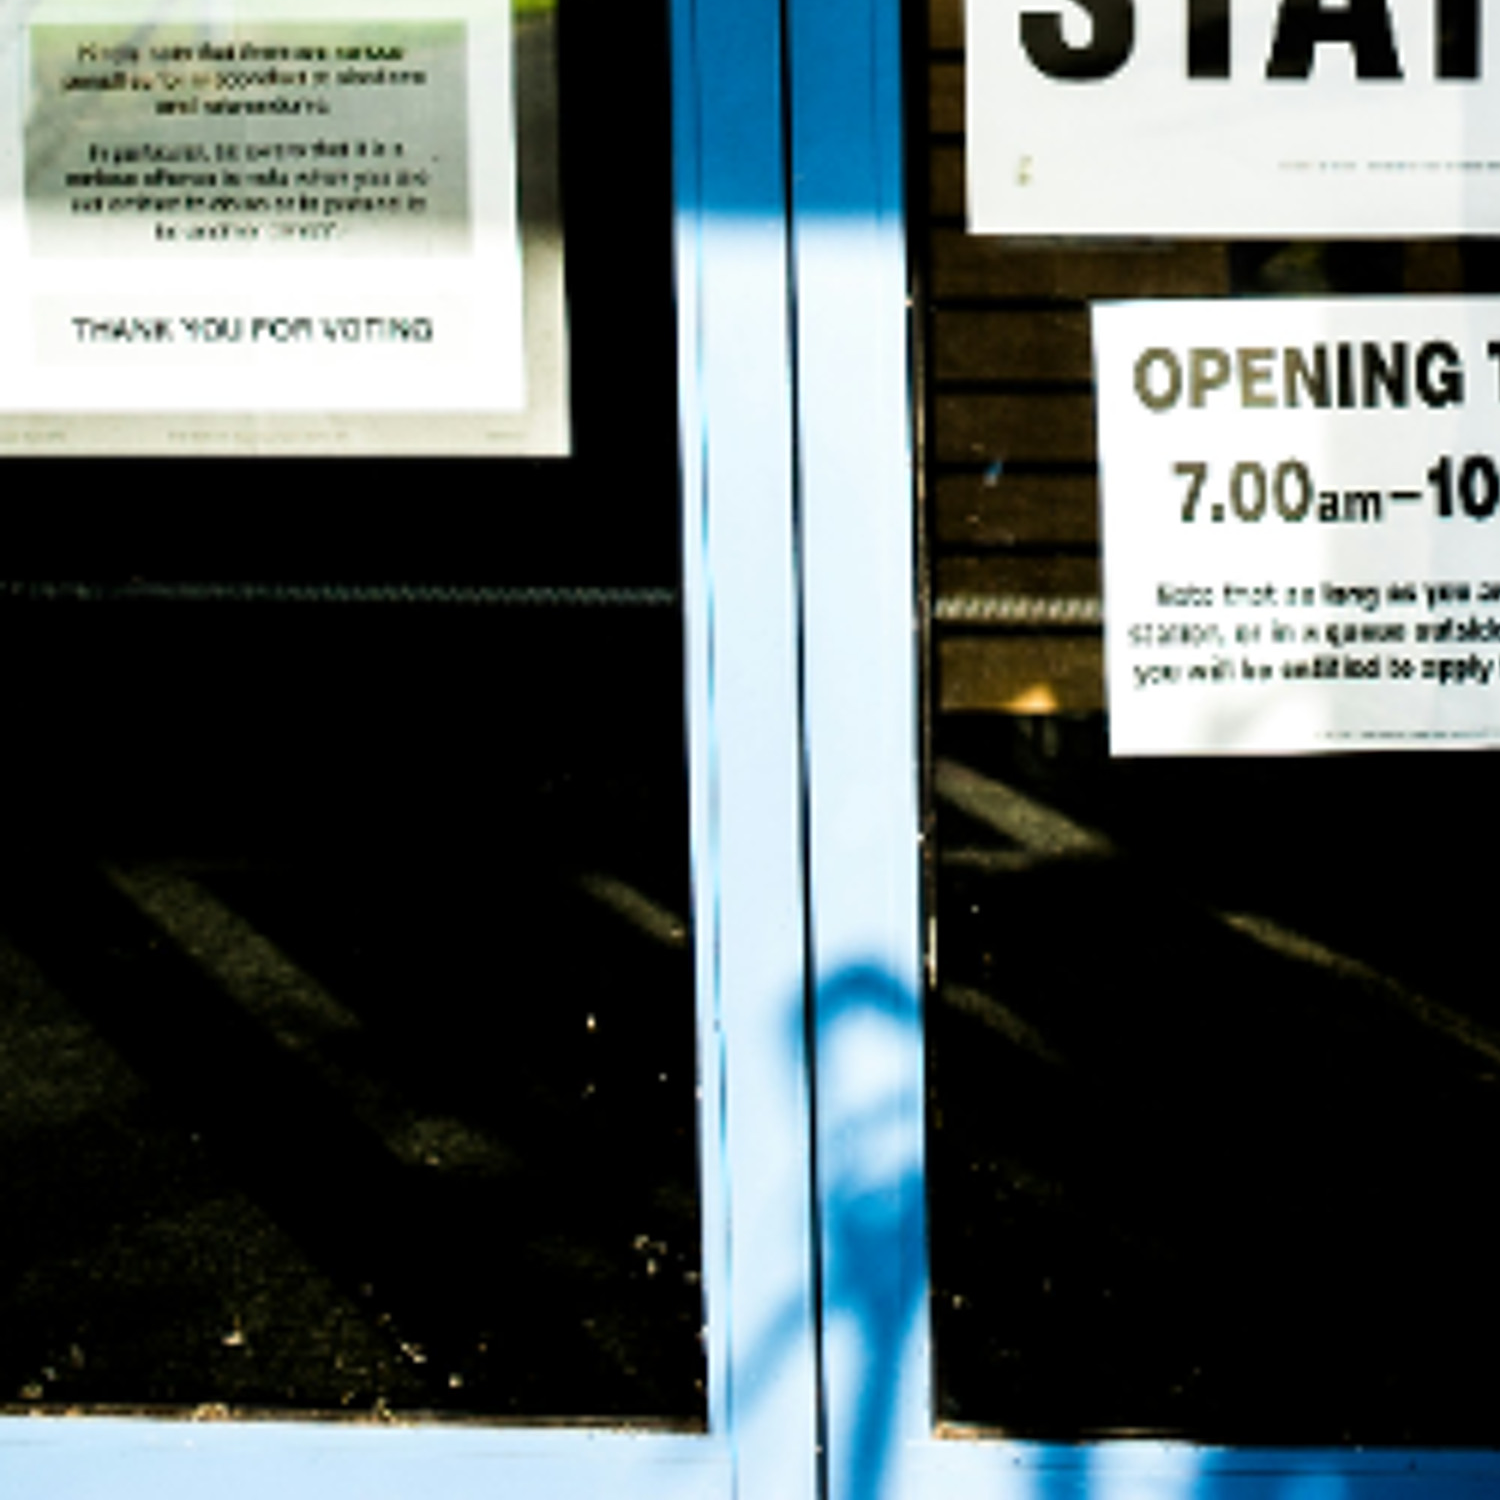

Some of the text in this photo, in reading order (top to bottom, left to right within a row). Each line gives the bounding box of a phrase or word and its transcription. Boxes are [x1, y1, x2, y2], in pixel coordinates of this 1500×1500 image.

[72, 317, 434, 342] THANK YOU FOR VOTING
[1133, 340, 1464, 411] OPENING
